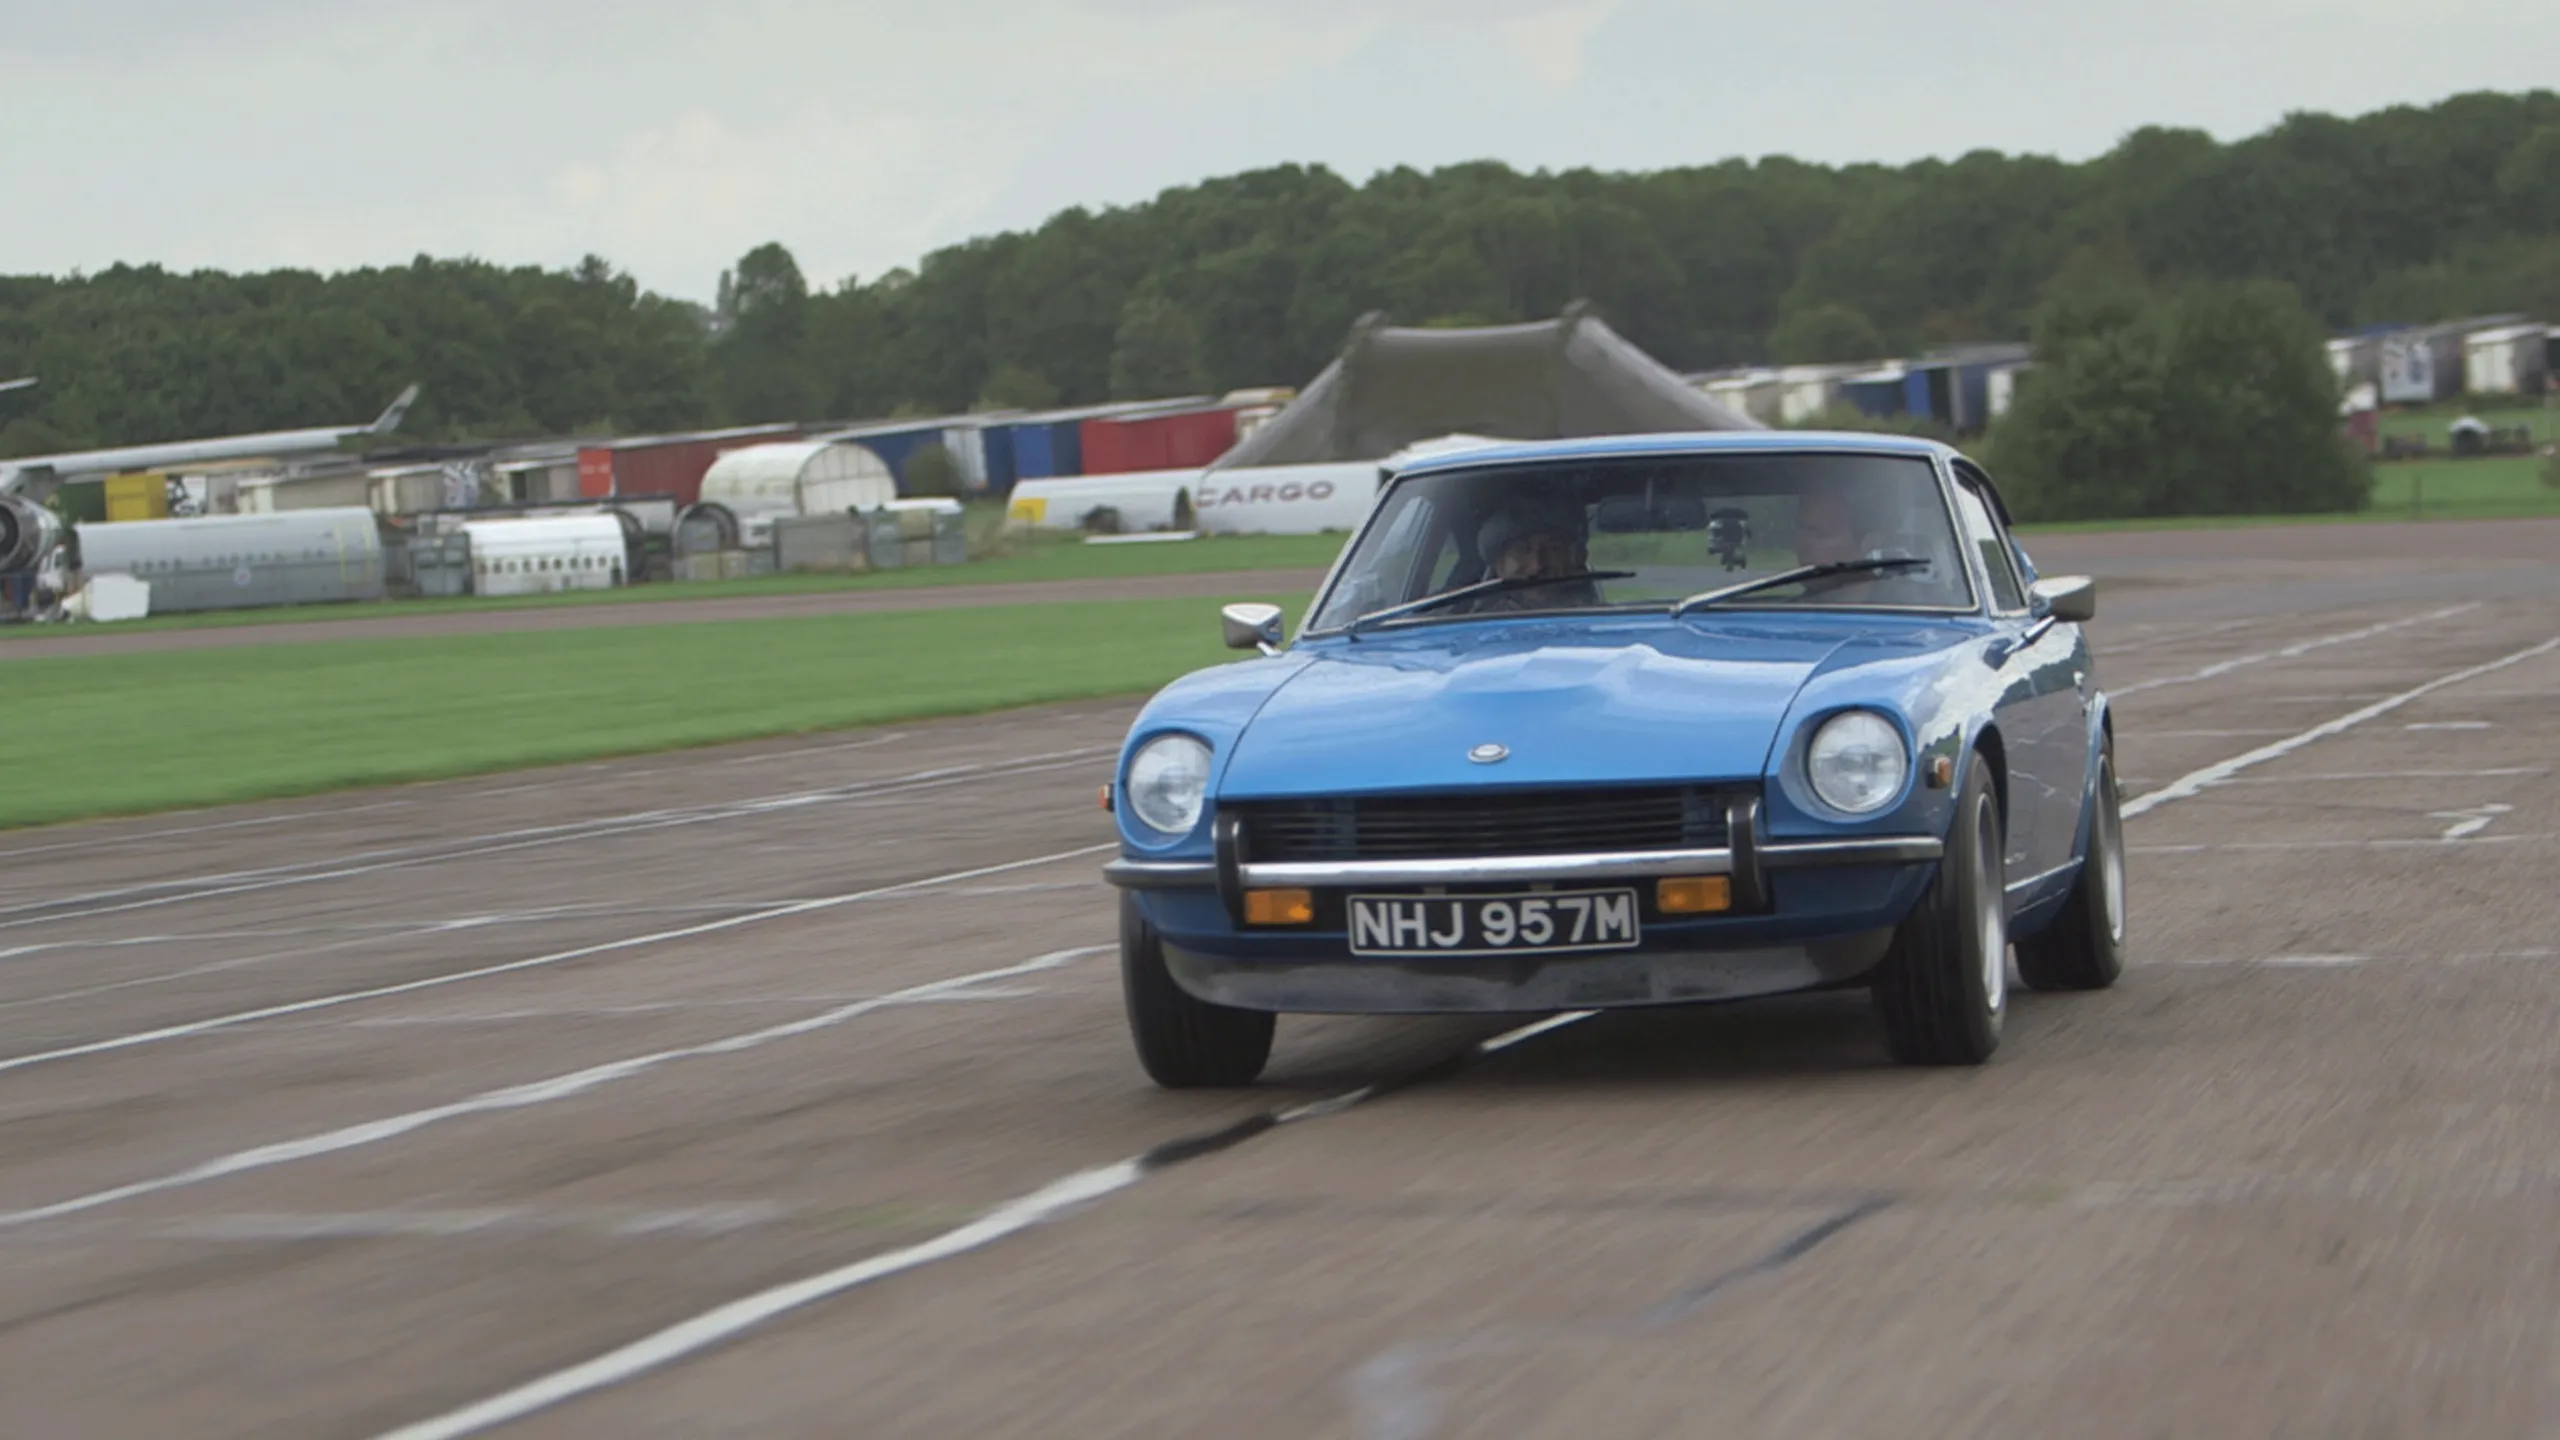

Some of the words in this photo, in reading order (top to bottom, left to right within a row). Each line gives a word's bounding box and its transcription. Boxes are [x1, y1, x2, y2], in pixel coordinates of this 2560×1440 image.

[1196, 480, 1335, 508] CARGO
[1354, 902, 1463, 946] NHJ
[1481, 895, 1632, 945] 957M
